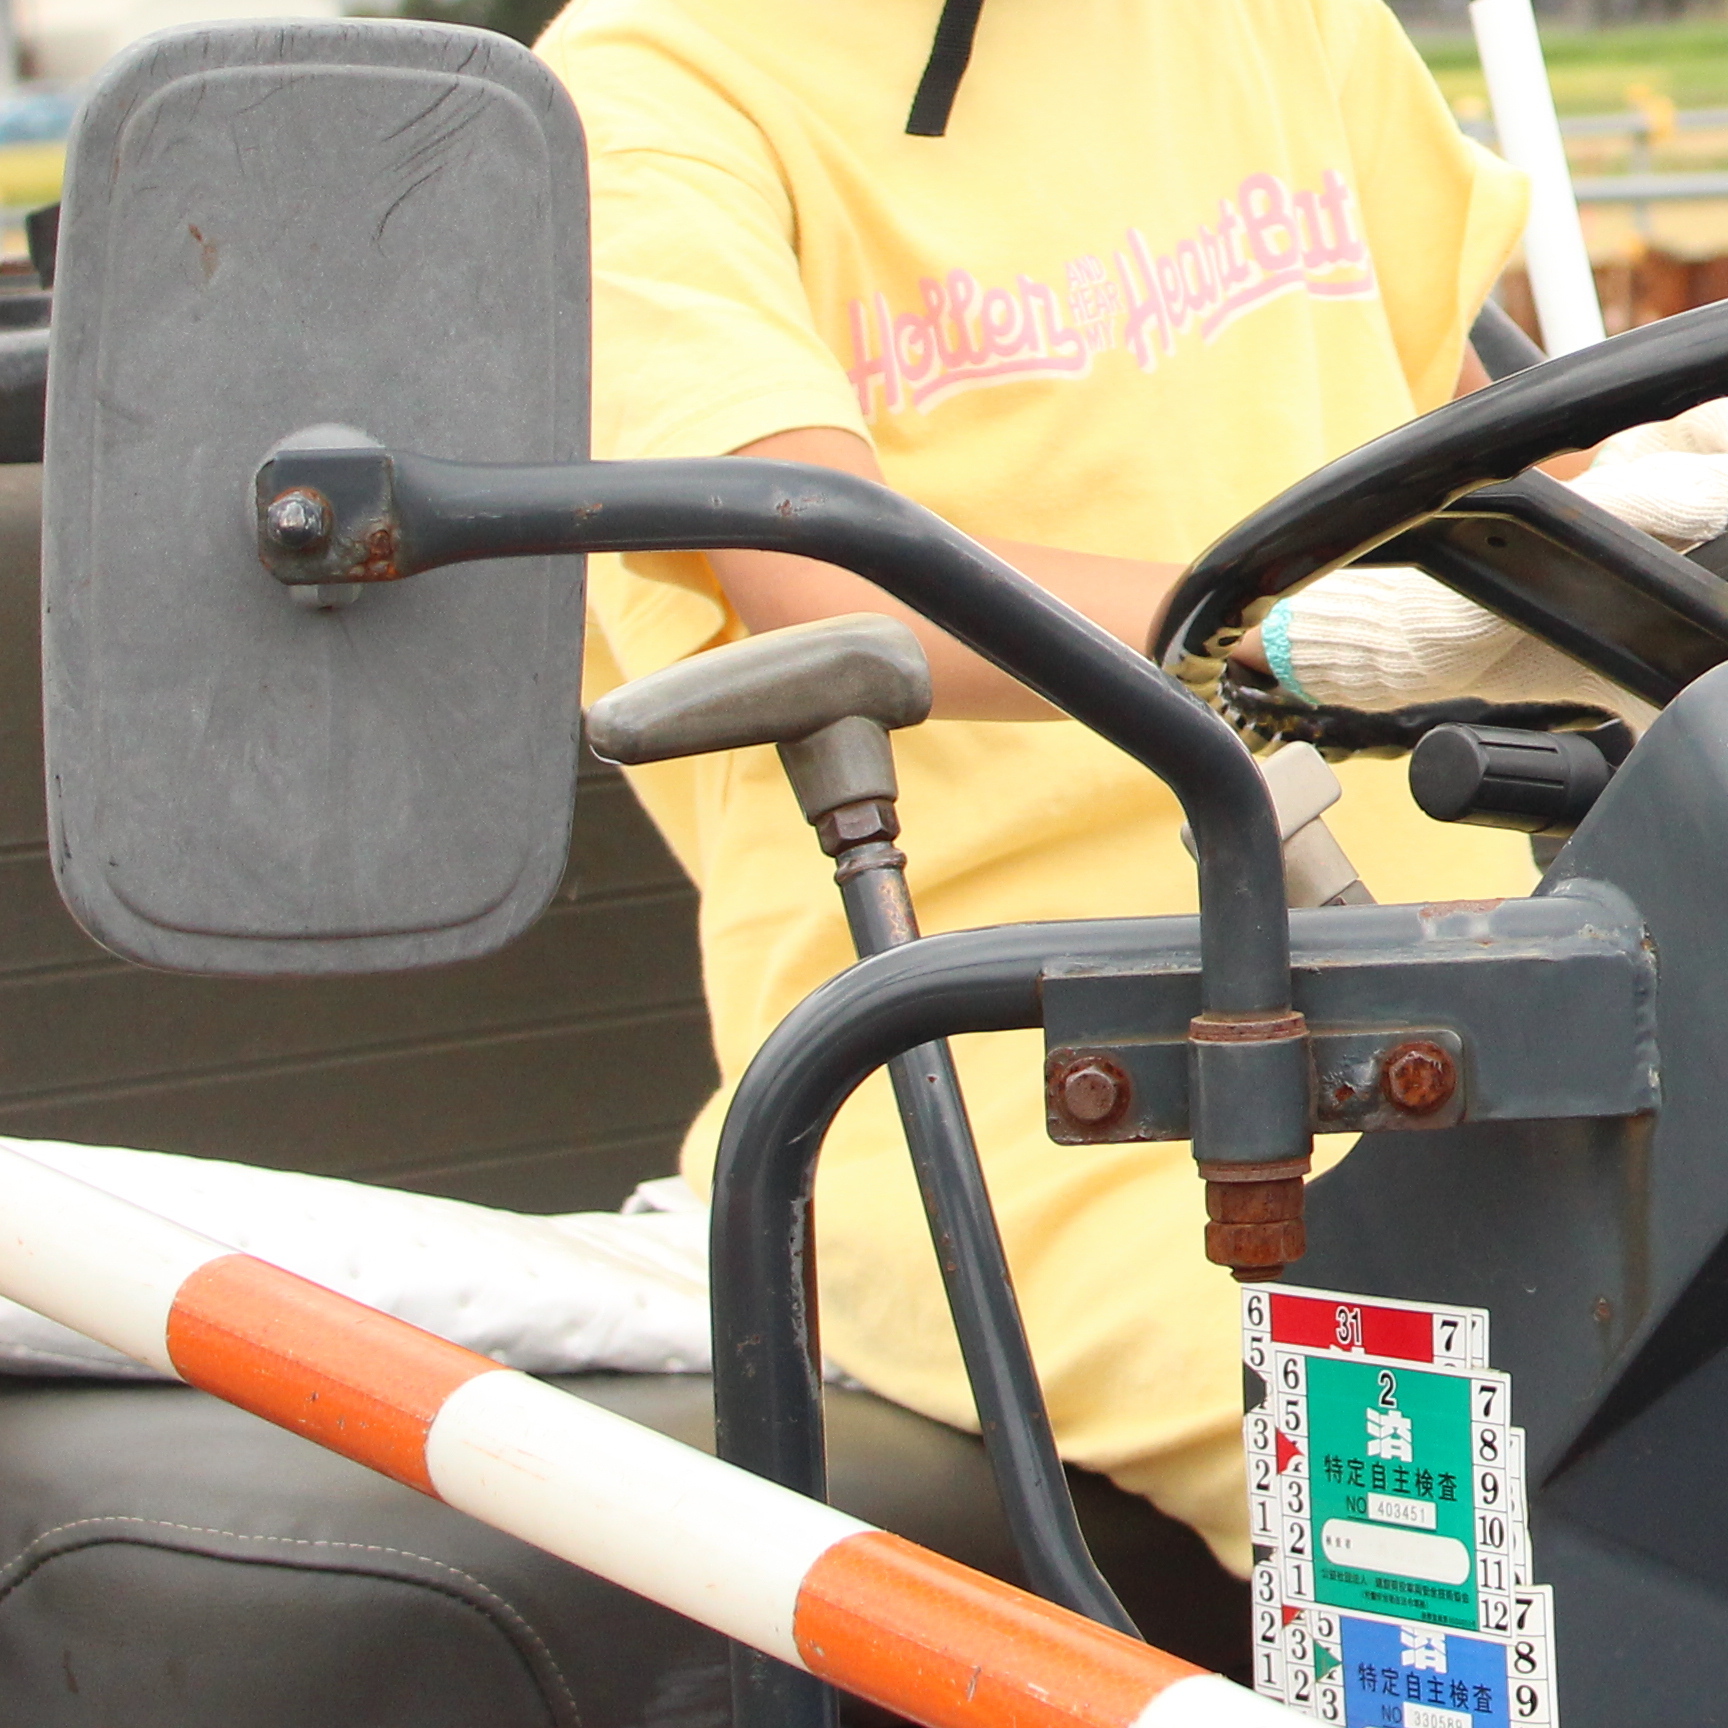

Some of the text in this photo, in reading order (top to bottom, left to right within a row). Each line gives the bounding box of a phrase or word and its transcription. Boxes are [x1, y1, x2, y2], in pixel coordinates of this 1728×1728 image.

[846, 268, 1088, 418] Holler
[1247, 1295, 1264, 1326] 6
[1335, 1306, 1363, 1346] 31
[1249, 1336, 1266, 1367] 5
[1439, 1320, 1458, 1352] 7
[1282, 1358, 1300, 1390] 6
[1378, 1370, 1398, 1408] 2
[1285, 1399, 1301, 1431] 5
[1478, 1385, 1497, 1417] 7
[1253, 1417, 1269, 1450] 3
[1365, 1407, 1414, 1463] 済
[1479, 1428, 1498, 1462] 8
[1255, 1459, 1271, 1491] 2
[1323, 1453, 1458, 1503] 特定自主検査
[1480, 1472, 1499, 1505] 9
[1287, 1480, 1304, 1514] 3
[1346, 1495, 1426, 1523] NO 403451
[1258, 1500, 1272, 1533] 1
[1478, 1515, 1505, 1549] 10
[1289, 1522, 1306, 1555] 2
[1258, 1570, 1275, 1602] 3
[1293, 1564, 1307, 1597] 1
[1479, 1557, 1506, 1590] 11
[1260, 1611, 1276, 1644] 2
[1480, 1598, 1509, 1632] 12
[1515, 1598, 1534, 1630] 7
[1291, 1628, 1308, 1661] 3
[1514, 1641, 1538, 1674] 8
[1262, 1653, 1276, 1685] 1
[1294, 1669, 1310, 1702] 2
[1321, 1688, 1339, 1721] 3
[1358, 1662, 1493, 1714] 特定自主検査
[1515, 1684, 1539, 1718] 9
[1381, 1705, 1403, 1723] NO
